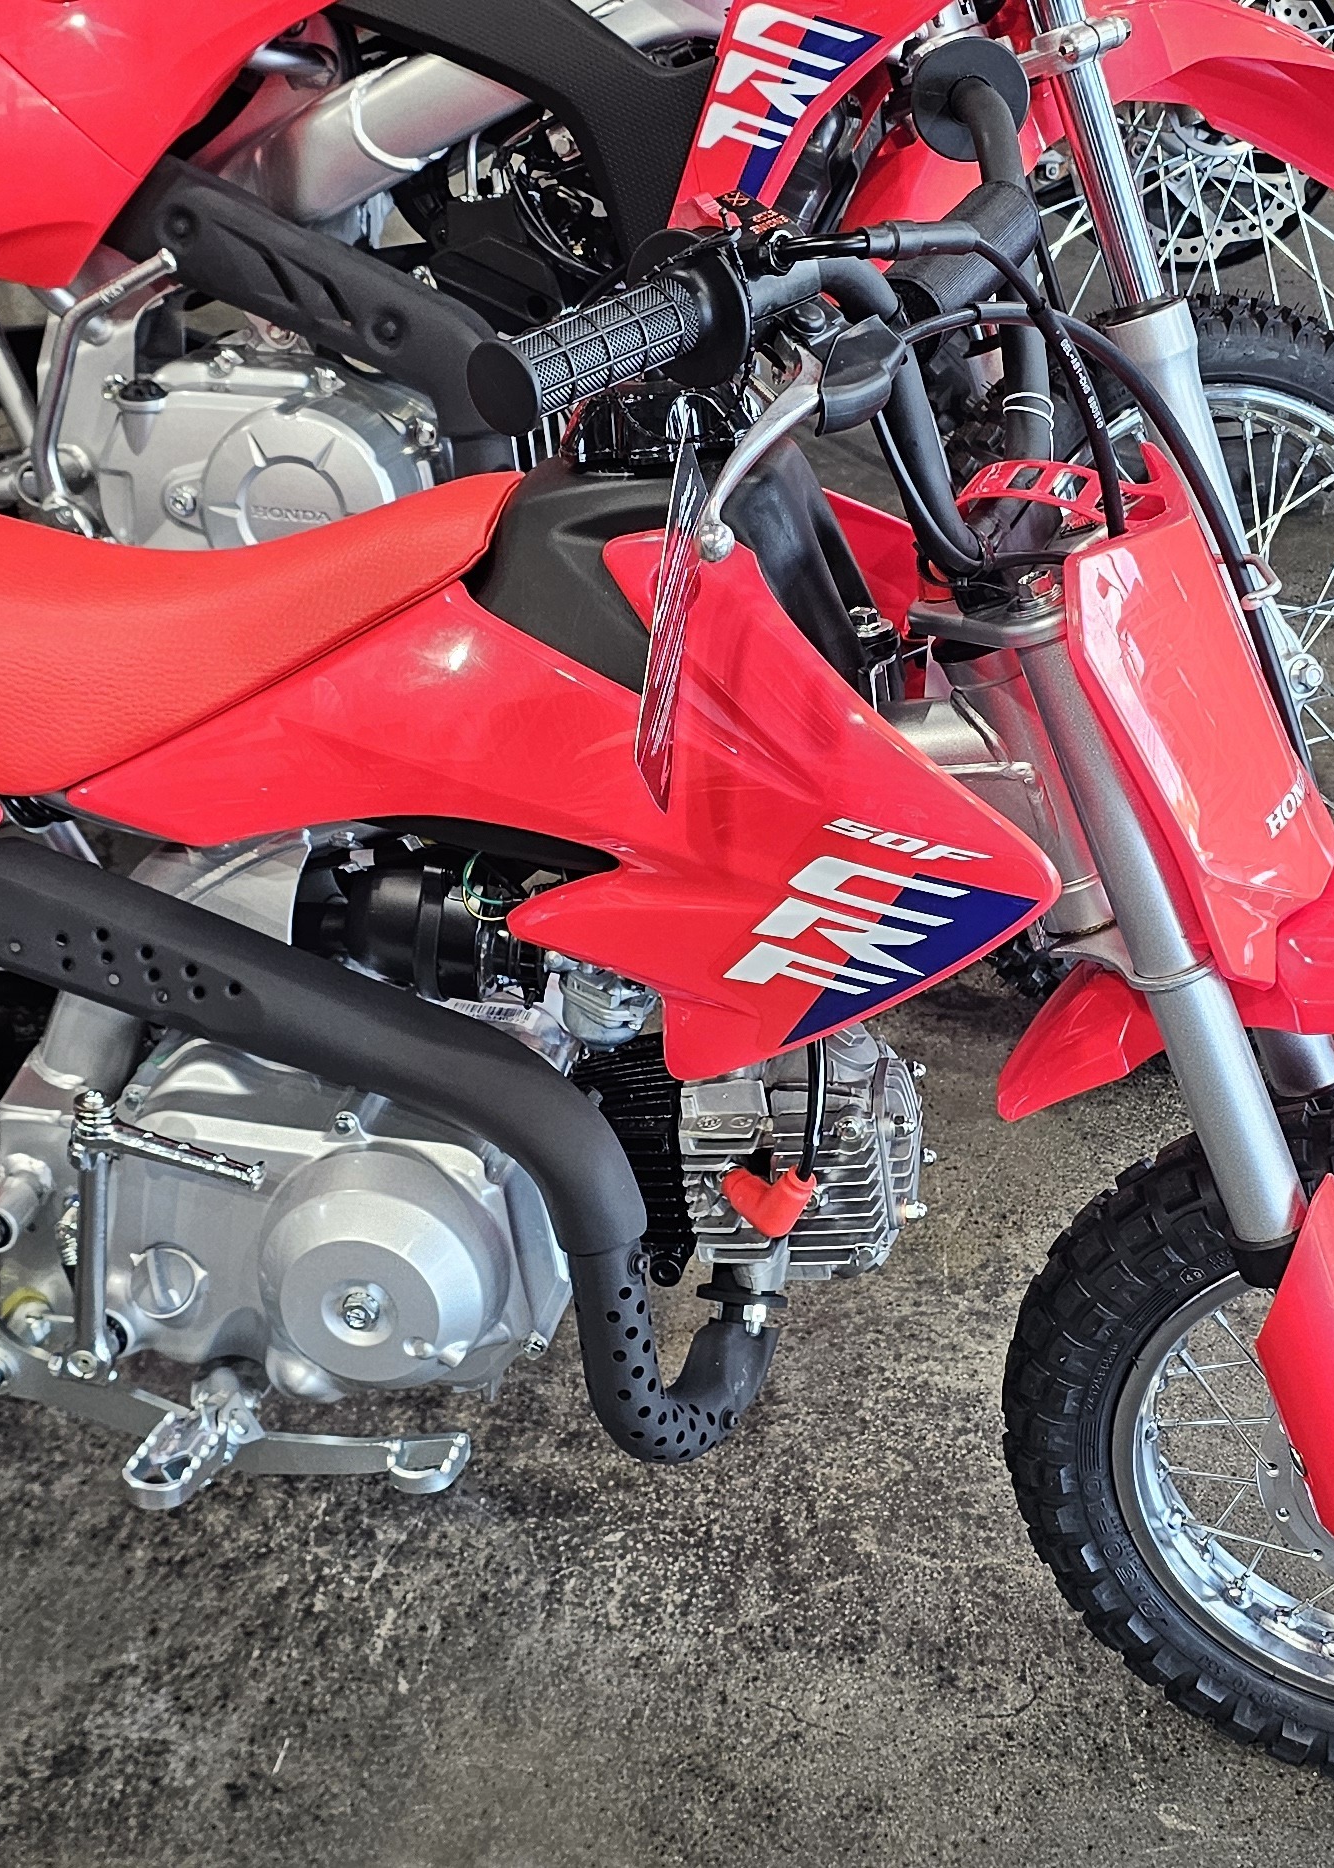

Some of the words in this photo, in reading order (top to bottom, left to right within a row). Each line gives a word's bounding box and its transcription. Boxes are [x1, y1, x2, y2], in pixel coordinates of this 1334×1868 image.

[251, 505, 331, 524] HONDA
[823, 818, 993, 860] 50F
[723, 856, 970, 995] CRF
